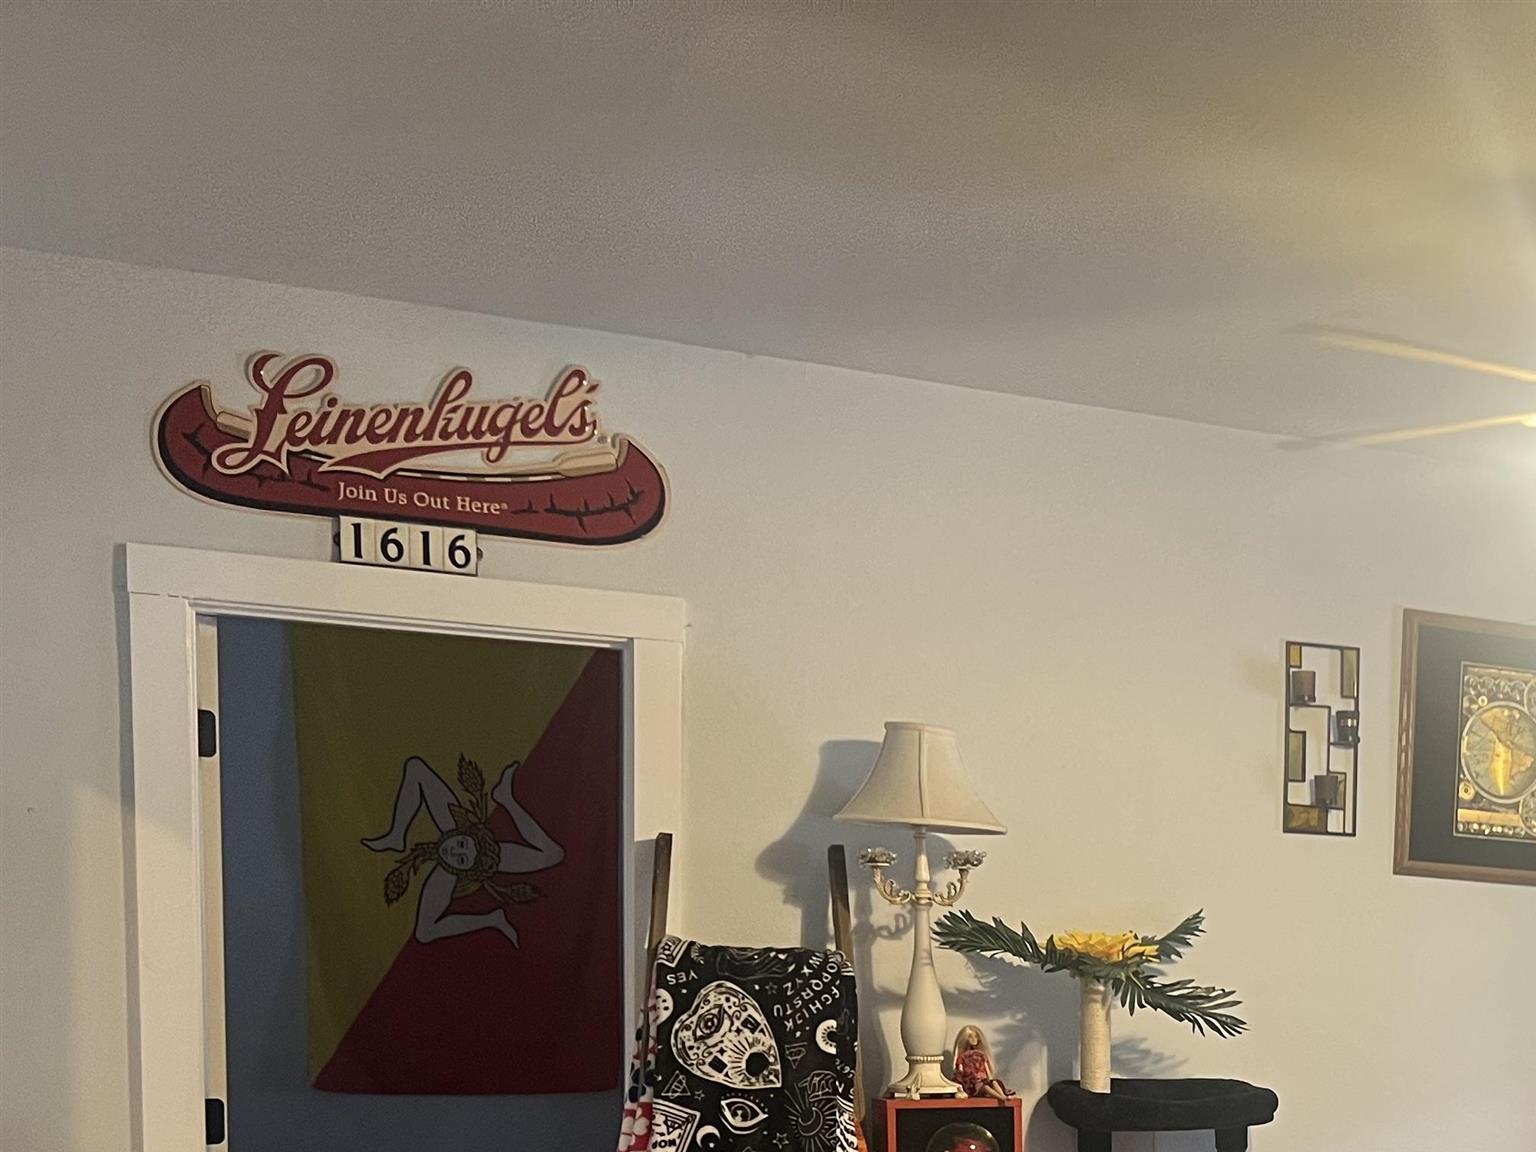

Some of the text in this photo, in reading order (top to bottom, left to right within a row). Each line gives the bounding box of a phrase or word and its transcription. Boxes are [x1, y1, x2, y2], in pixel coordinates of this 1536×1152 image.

[211, 353, 598, 478] Leinenkugel's
[338, 482, 377, 501] Join
[384, 488, 407, 505] Us
[414, 492, 449, 510] Out
[351, 523, 471, 569] 1616
